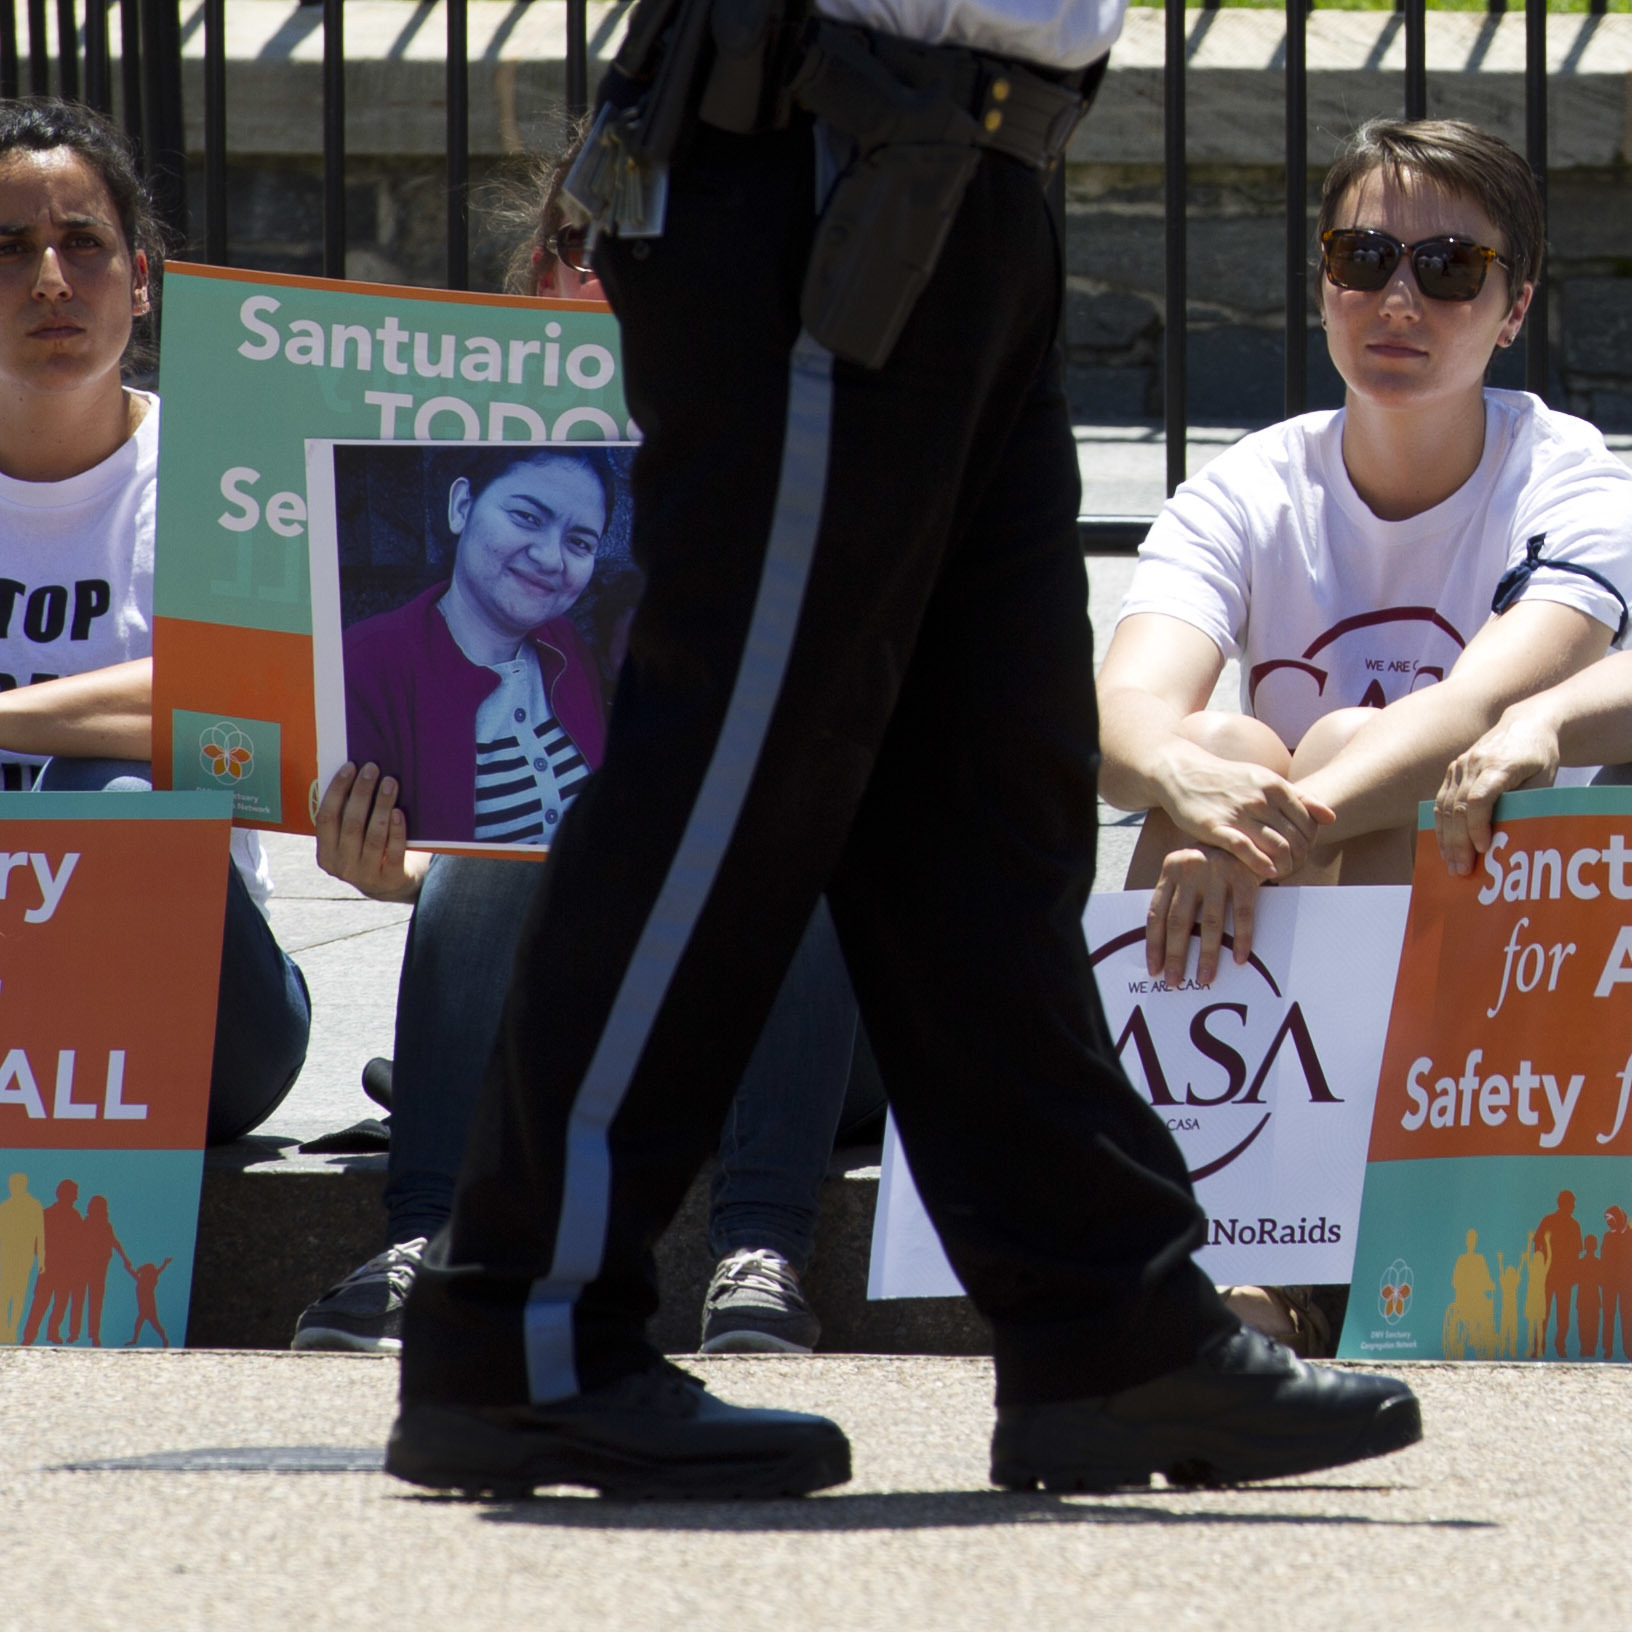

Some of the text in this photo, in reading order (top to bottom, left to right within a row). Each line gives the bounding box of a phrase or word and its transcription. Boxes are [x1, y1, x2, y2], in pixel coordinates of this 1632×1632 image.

[237, 294, 615, 390] Santuario
[363, 390, 642, 441] TODO
[1364, 658, 1385, 672] WE
[1486, 917, 1577, 1019] for
[1400, 1049, 1586, 1148] Safety
